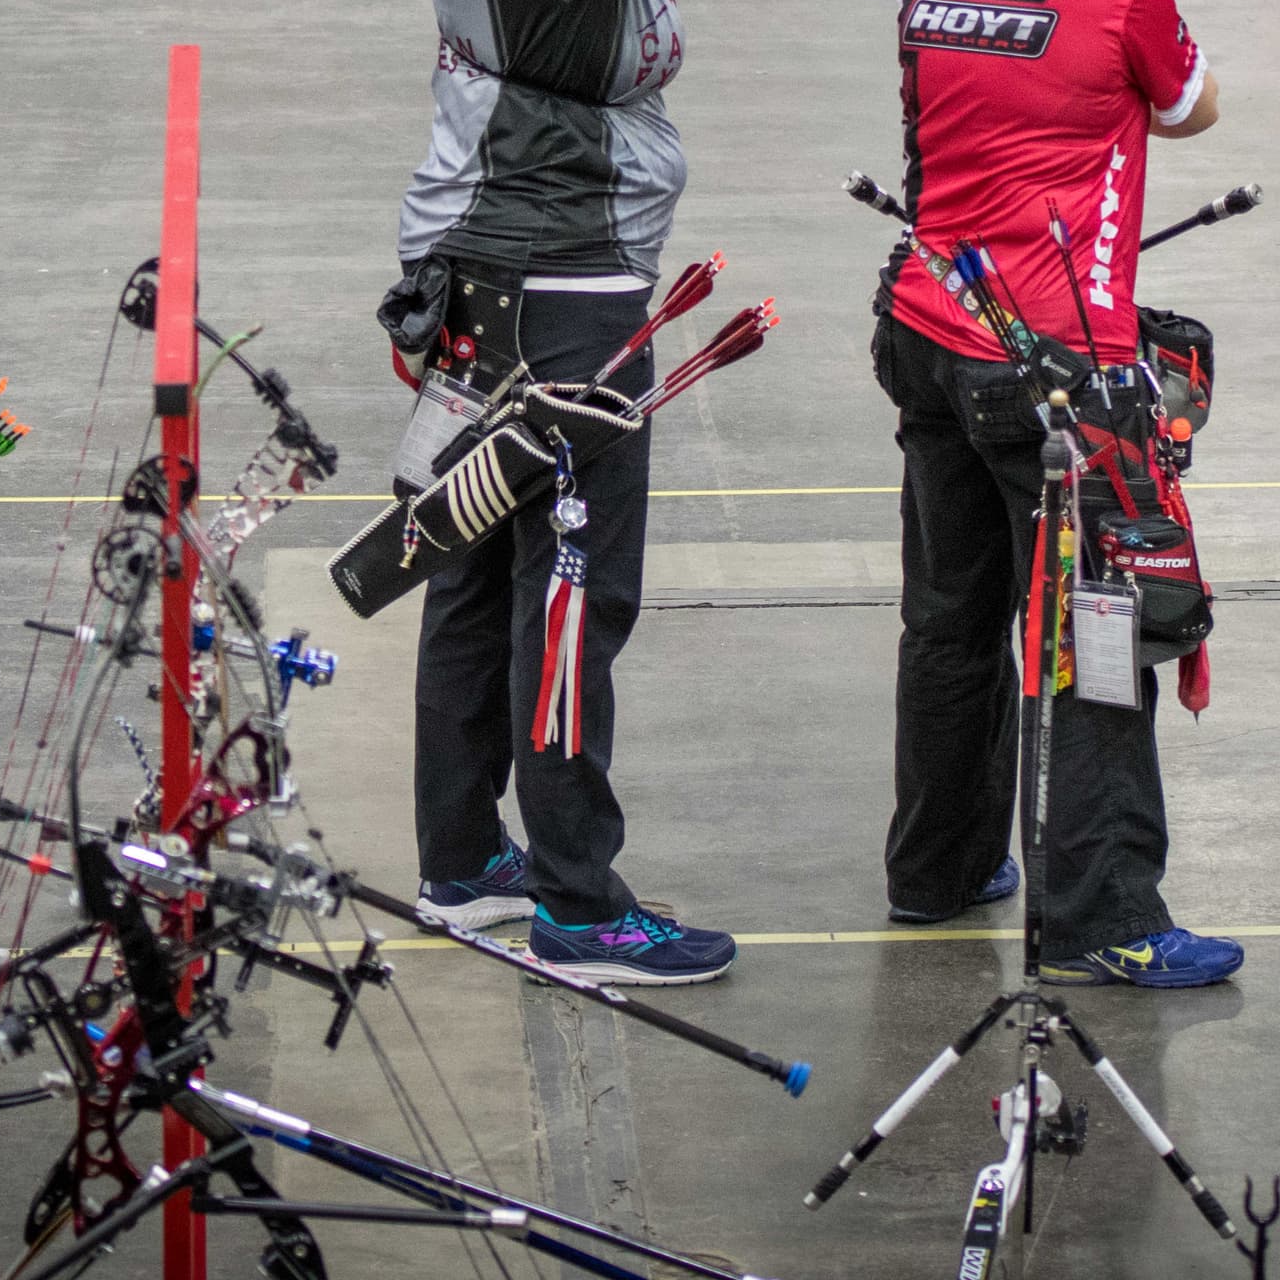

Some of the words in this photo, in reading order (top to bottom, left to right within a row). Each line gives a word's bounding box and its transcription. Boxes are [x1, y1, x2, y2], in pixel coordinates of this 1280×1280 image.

[909, 2, 1051, 41] HOYT
[912, 31, 1029, 50] ARCHERY
[1133, 556, 1191, 570] EASTON
